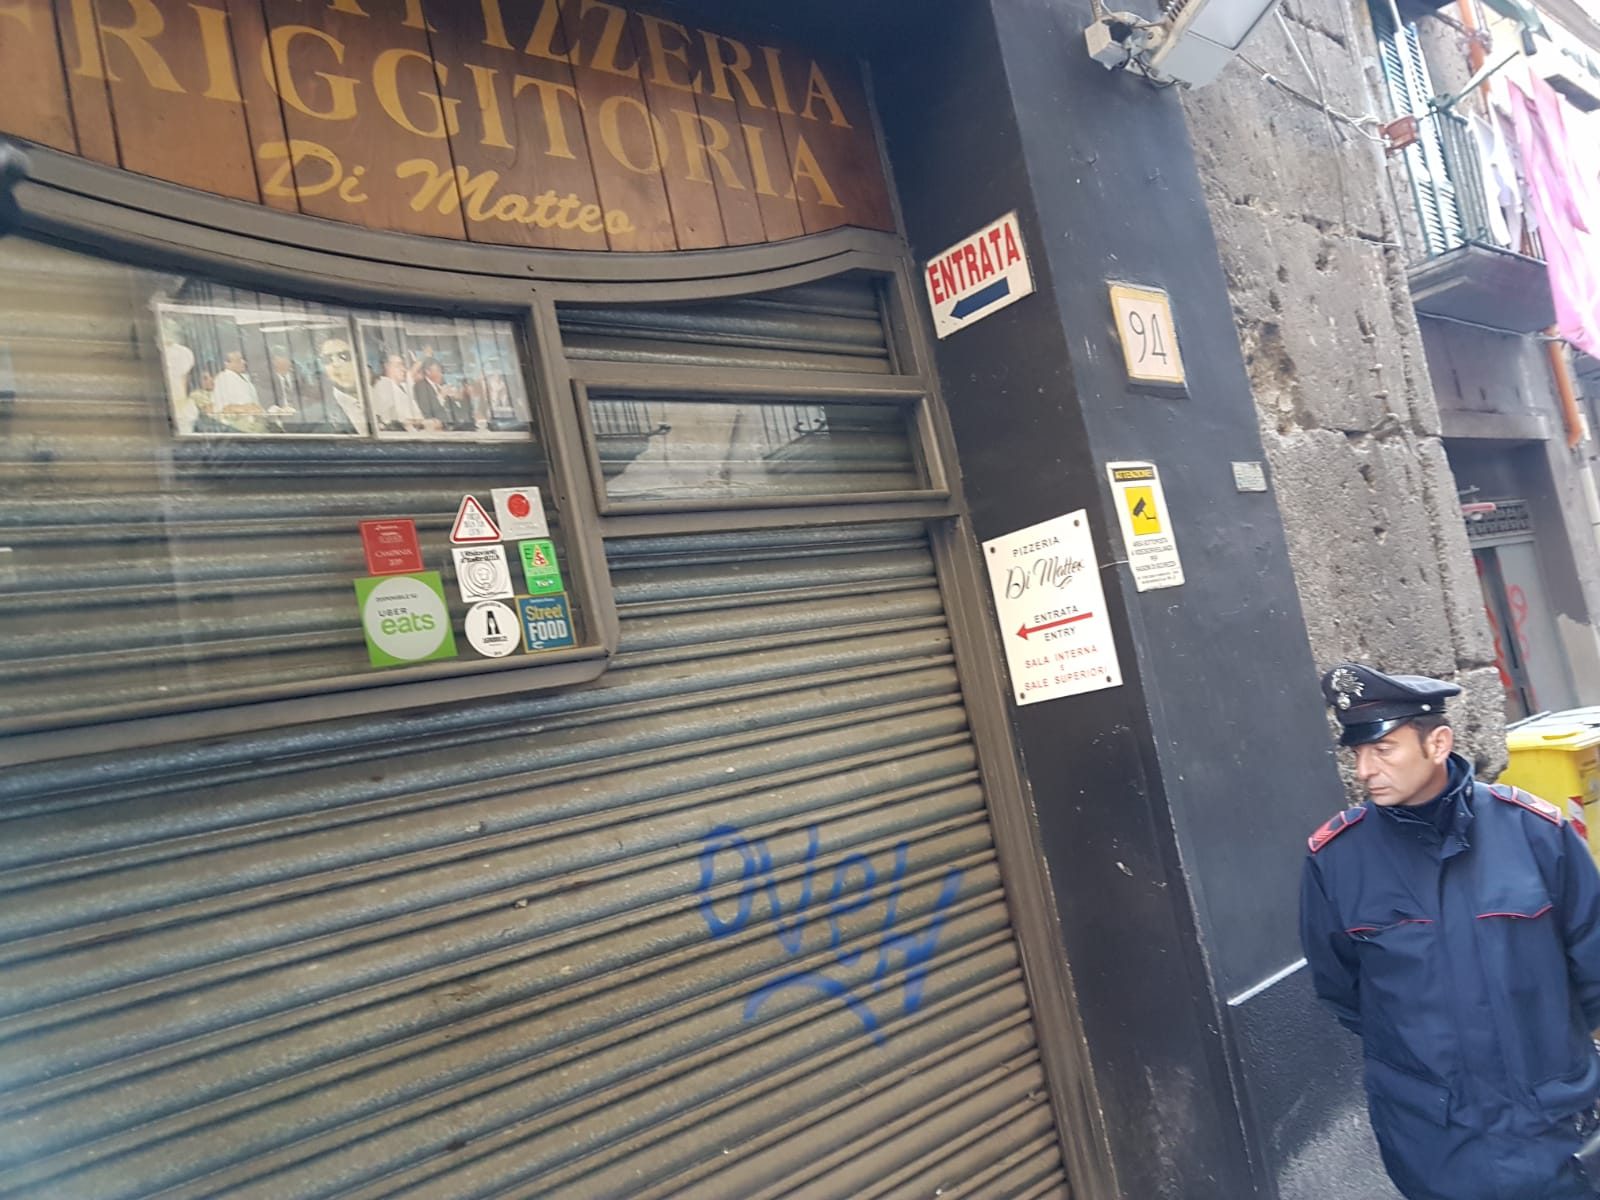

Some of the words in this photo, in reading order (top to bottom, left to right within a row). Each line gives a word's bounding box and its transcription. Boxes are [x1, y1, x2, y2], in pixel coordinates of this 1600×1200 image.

[258, 139, 369, 203] Di
[396, 158, 636, 234] Matteo
[926, 222, 1021, 305] ENTRATA
[1128, 310, 1168, 365] 94
[1012, 536, 1060, 558] PIZZERIA
[377, 607, 408, 617] UBER
[525, 604, 564, 621] Street
[1034, 604, 1079, 624] ENTRATA
[381, 612, 435, 635] eats
[528, 620, 568, 642] FOOD
[1044, 626, 1076, 642] ENTRY
[1024, 655, 1050, 669] SALA
[1055, 645, 1098, 662] INTERNA
[1024, 678, 1049, 691] SALE
[1054, 666, 1108, 685] SUPERIORI
